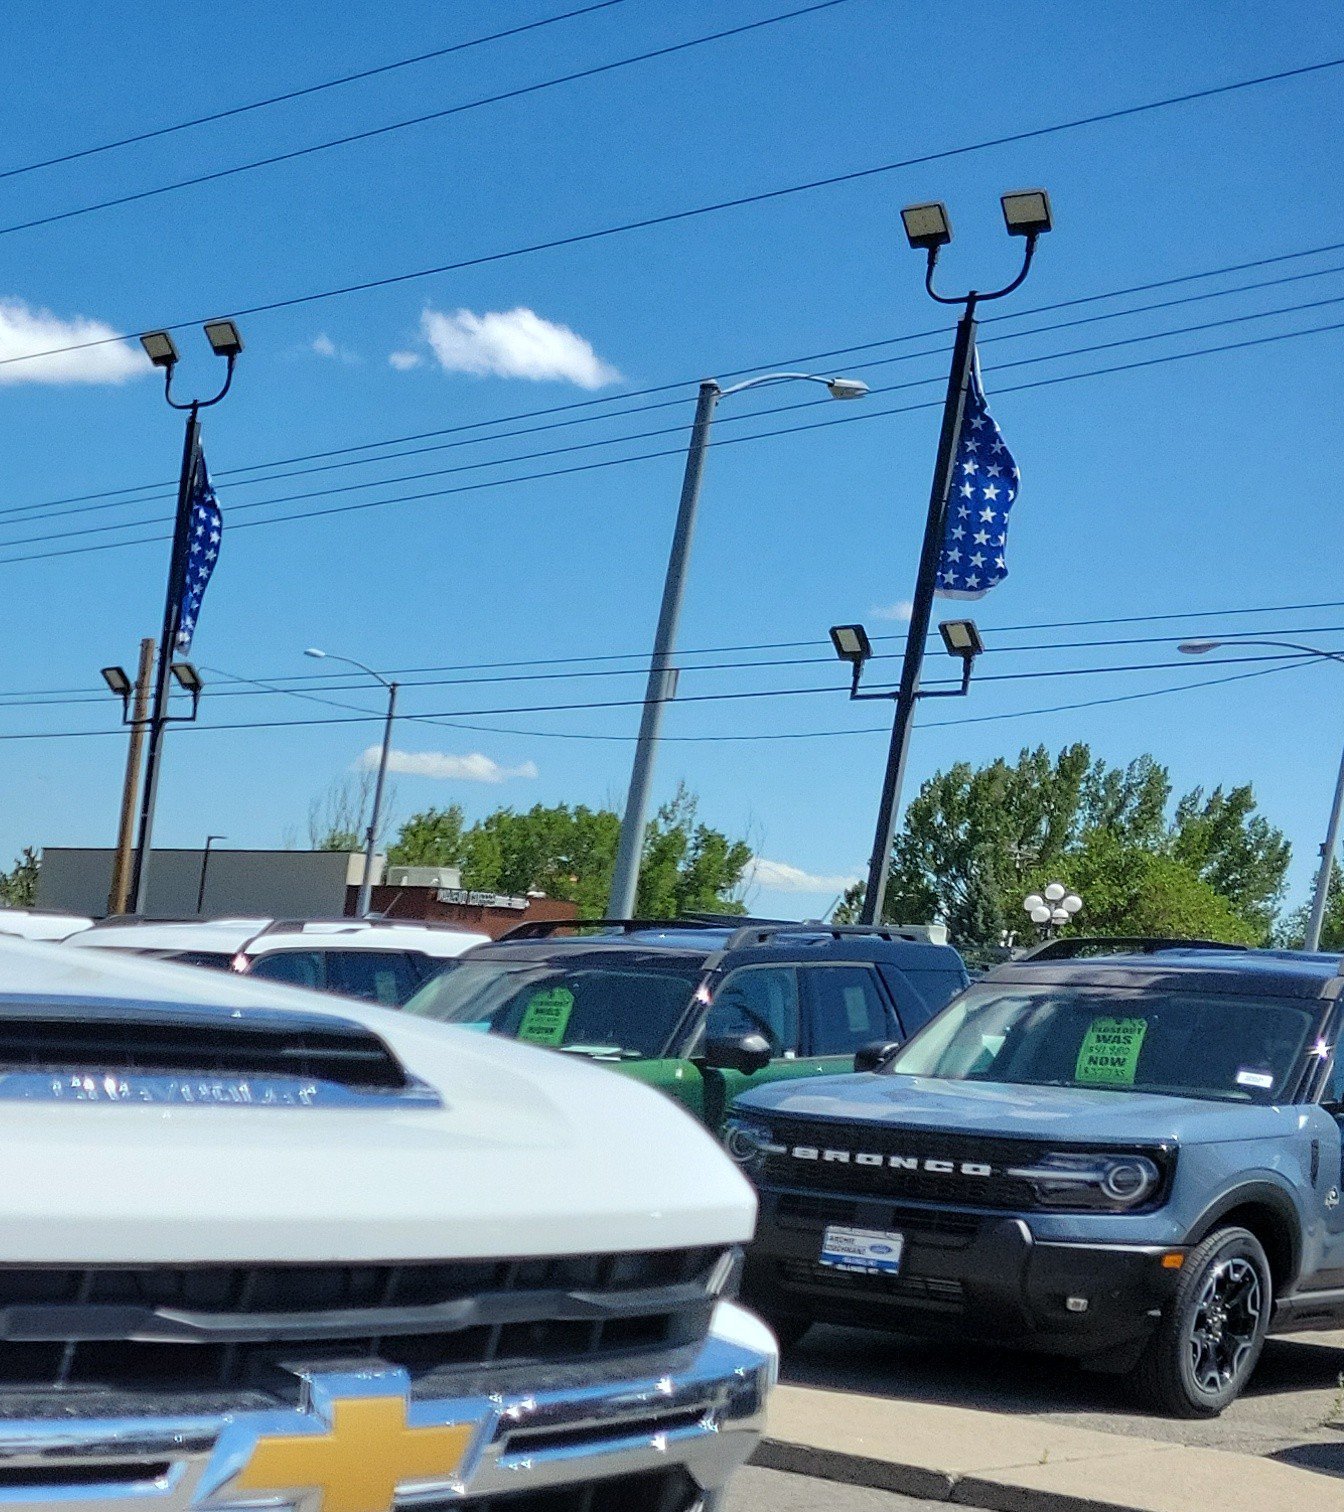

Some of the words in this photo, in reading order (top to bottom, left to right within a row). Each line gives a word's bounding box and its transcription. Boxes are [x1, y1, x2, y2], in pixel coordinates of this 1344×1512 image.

[1095, 1034, 1133, 1045] WAS
[1087, 1055, 1127, 1067] NOW
[792, 1147, 992, 1176] BRONCO
